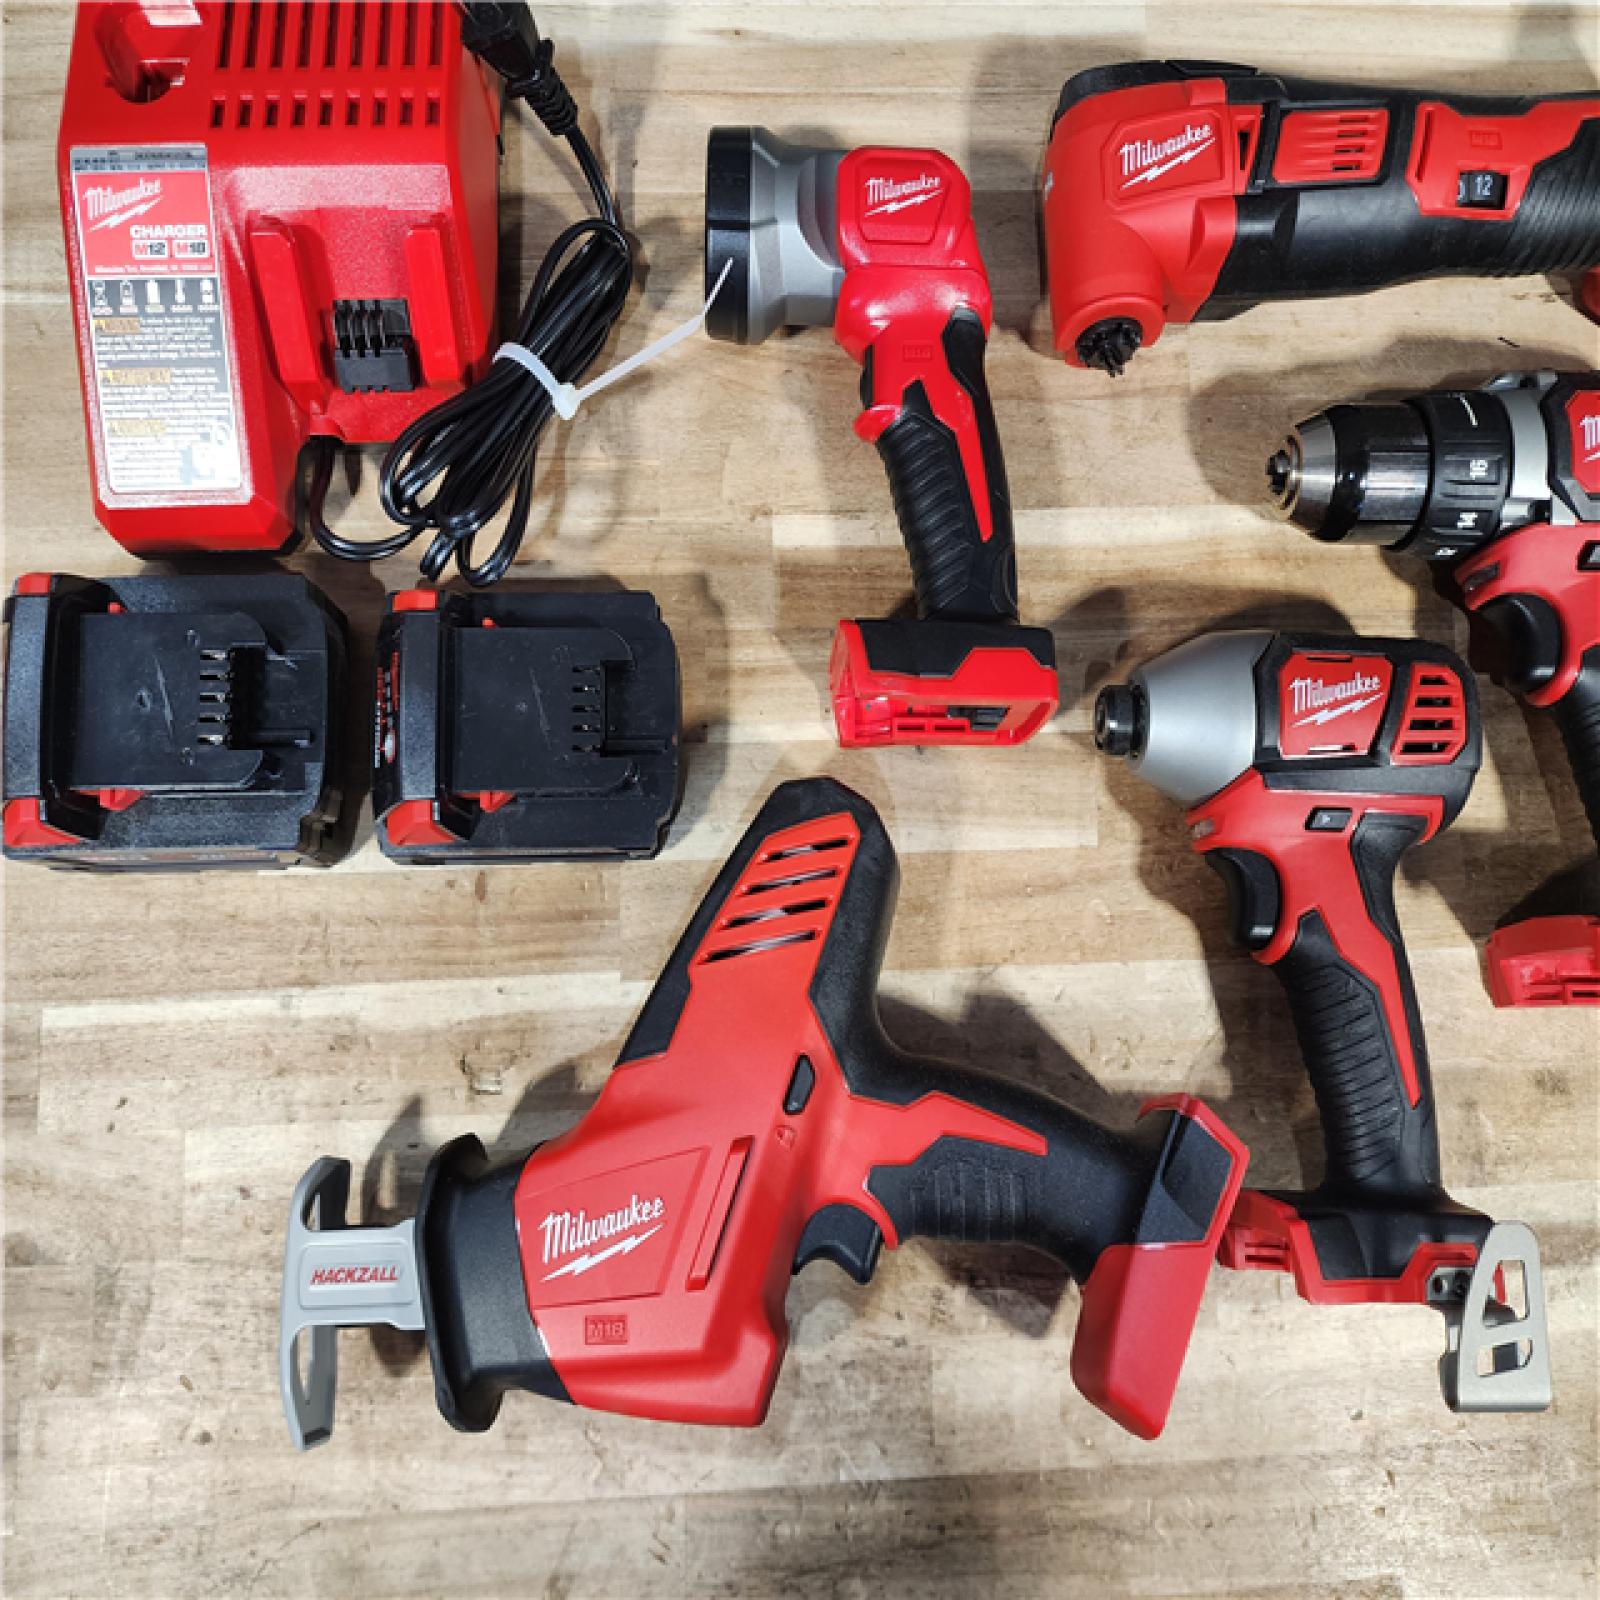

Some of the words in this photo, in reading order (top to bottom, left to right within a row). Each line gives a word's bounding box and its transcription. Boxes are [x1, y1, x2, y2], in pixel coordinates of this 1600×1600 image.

[1118, 122, 1213, 176] Milwaukee
[82, 176, 163, 221] Milwaukee
[863, 171, 941, 206] Milwaukee
[1474, 173, 1494, 197] 12
[129, 223, 208, 239] CHARGER
[1287, 671, 1382, 716] Milwaukee
[536, 1193, 666, 1265] Milwaukee
[310, 1265, 399, 1286] HACKZALL
